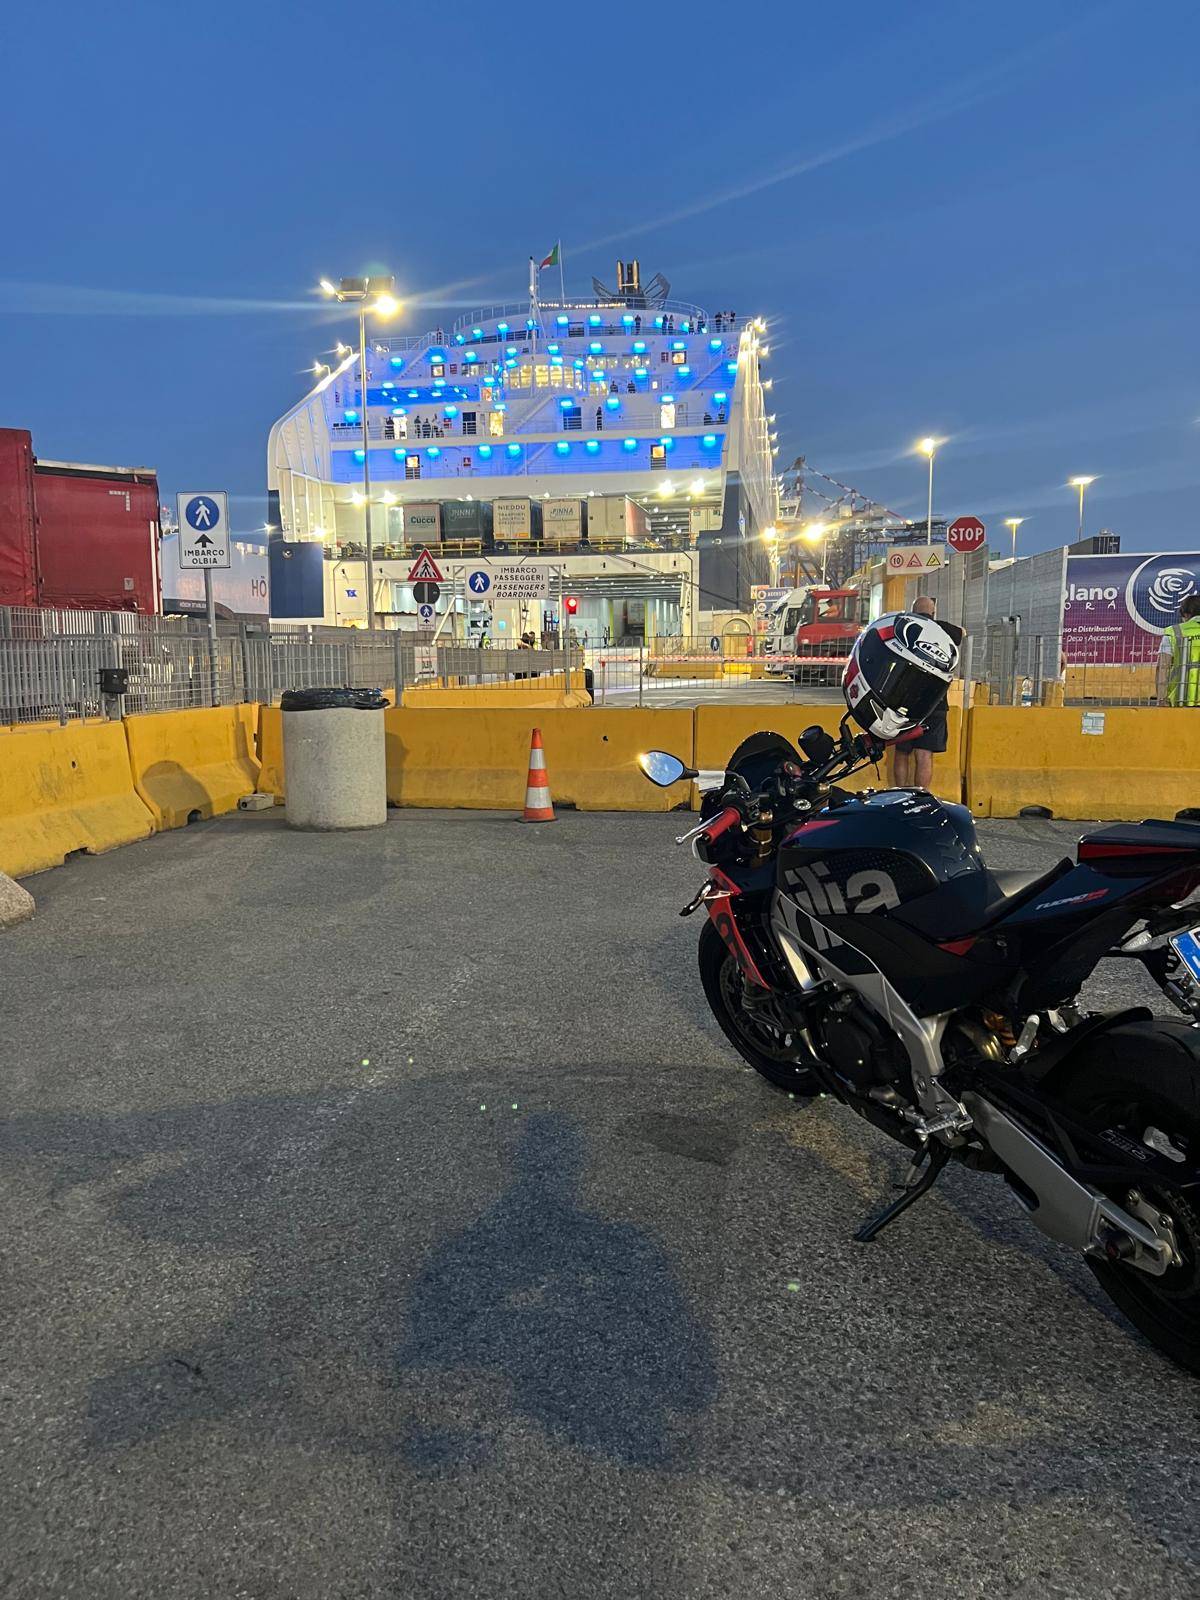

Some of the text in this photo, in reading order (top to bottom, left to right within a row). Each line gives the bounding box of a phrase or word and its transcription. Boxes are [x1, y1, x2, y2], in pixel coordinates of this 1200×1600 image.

[950, 527, 983, 542] STOP
[184, 549, 225, 557] IMBARCO
[192, 557, 218, 565] OLBIA
[492, 583, 546, 591] PASSENGERS
[1078, 625, 1122, 633] Distribuzione
[921, 643, 946, 661] HJC
